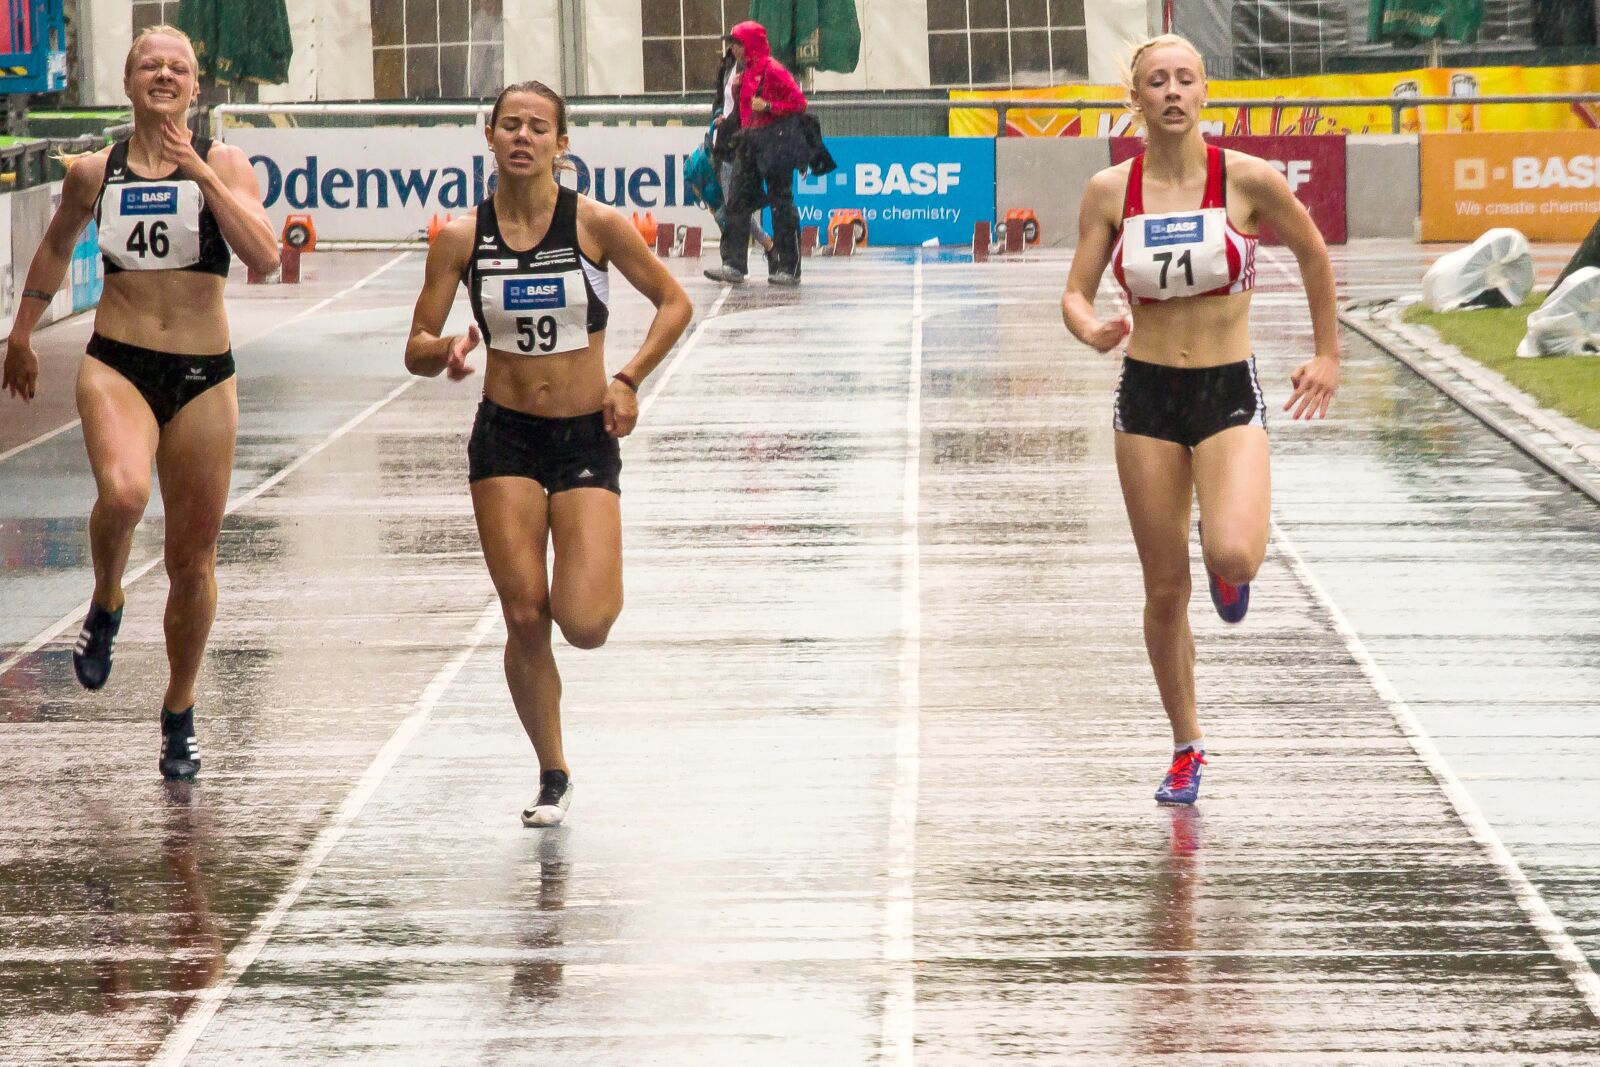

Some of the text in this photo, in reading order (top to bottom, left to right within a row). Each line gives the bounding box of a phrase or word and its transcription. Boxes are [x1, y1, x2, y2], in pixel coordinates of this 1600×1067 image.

[249, 155, 500, 209] Odenwal
[855, 162, 961, 195] BASF
[1512, 155, 1600, 189] BAS
[142, 192, 171, 203] BASF
[798, 205, 823, 220] We
[882, 205, 960, 223] chemistry
[1455, 199, 1600, 215] We create chemis
[126, 220, 170, 258] 46
[1166, 222, 1197, 233] BASF
[1153, 250, 1194, 289] 71
[527, 284, 558, 296] BASF
[516, 315, 558, 352] 59
